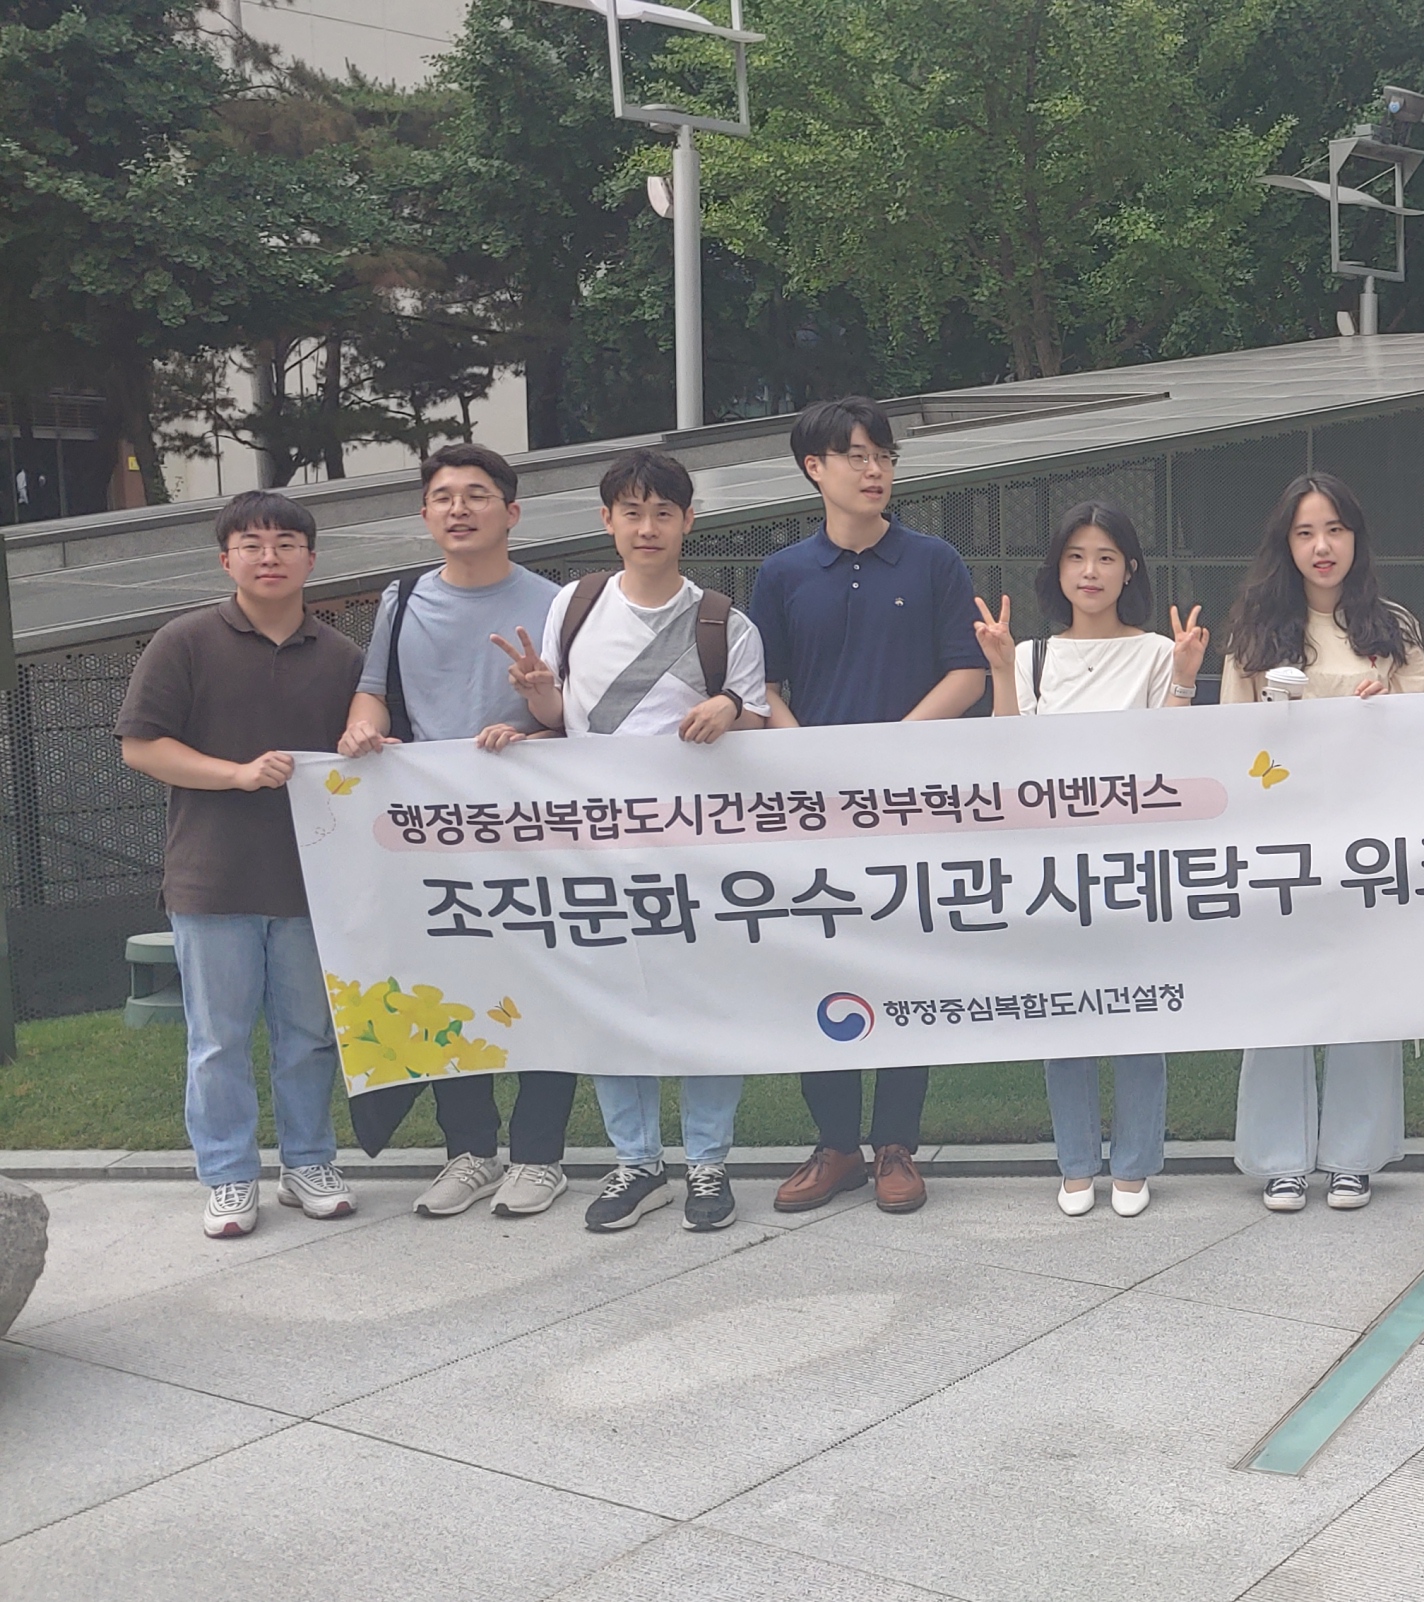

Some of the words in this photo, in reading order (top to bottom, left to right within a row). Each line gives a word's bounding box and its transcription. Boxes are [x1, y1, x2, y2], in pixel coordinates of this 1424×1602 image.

[386, 790, 827, 846] 행정중심복합도시건설청
[838, 781, 1005, 829] 정부혁신
[1017, 773, 1182, 819] 어벤져스
[422, 873, 701, 949] 조직문화
[715, 856, 1012, 944] 우수기관
[1025, 843, 1322, 927] 사례탐구
[882, 983, 1184, 1027] 행정중심복합도시건설청
